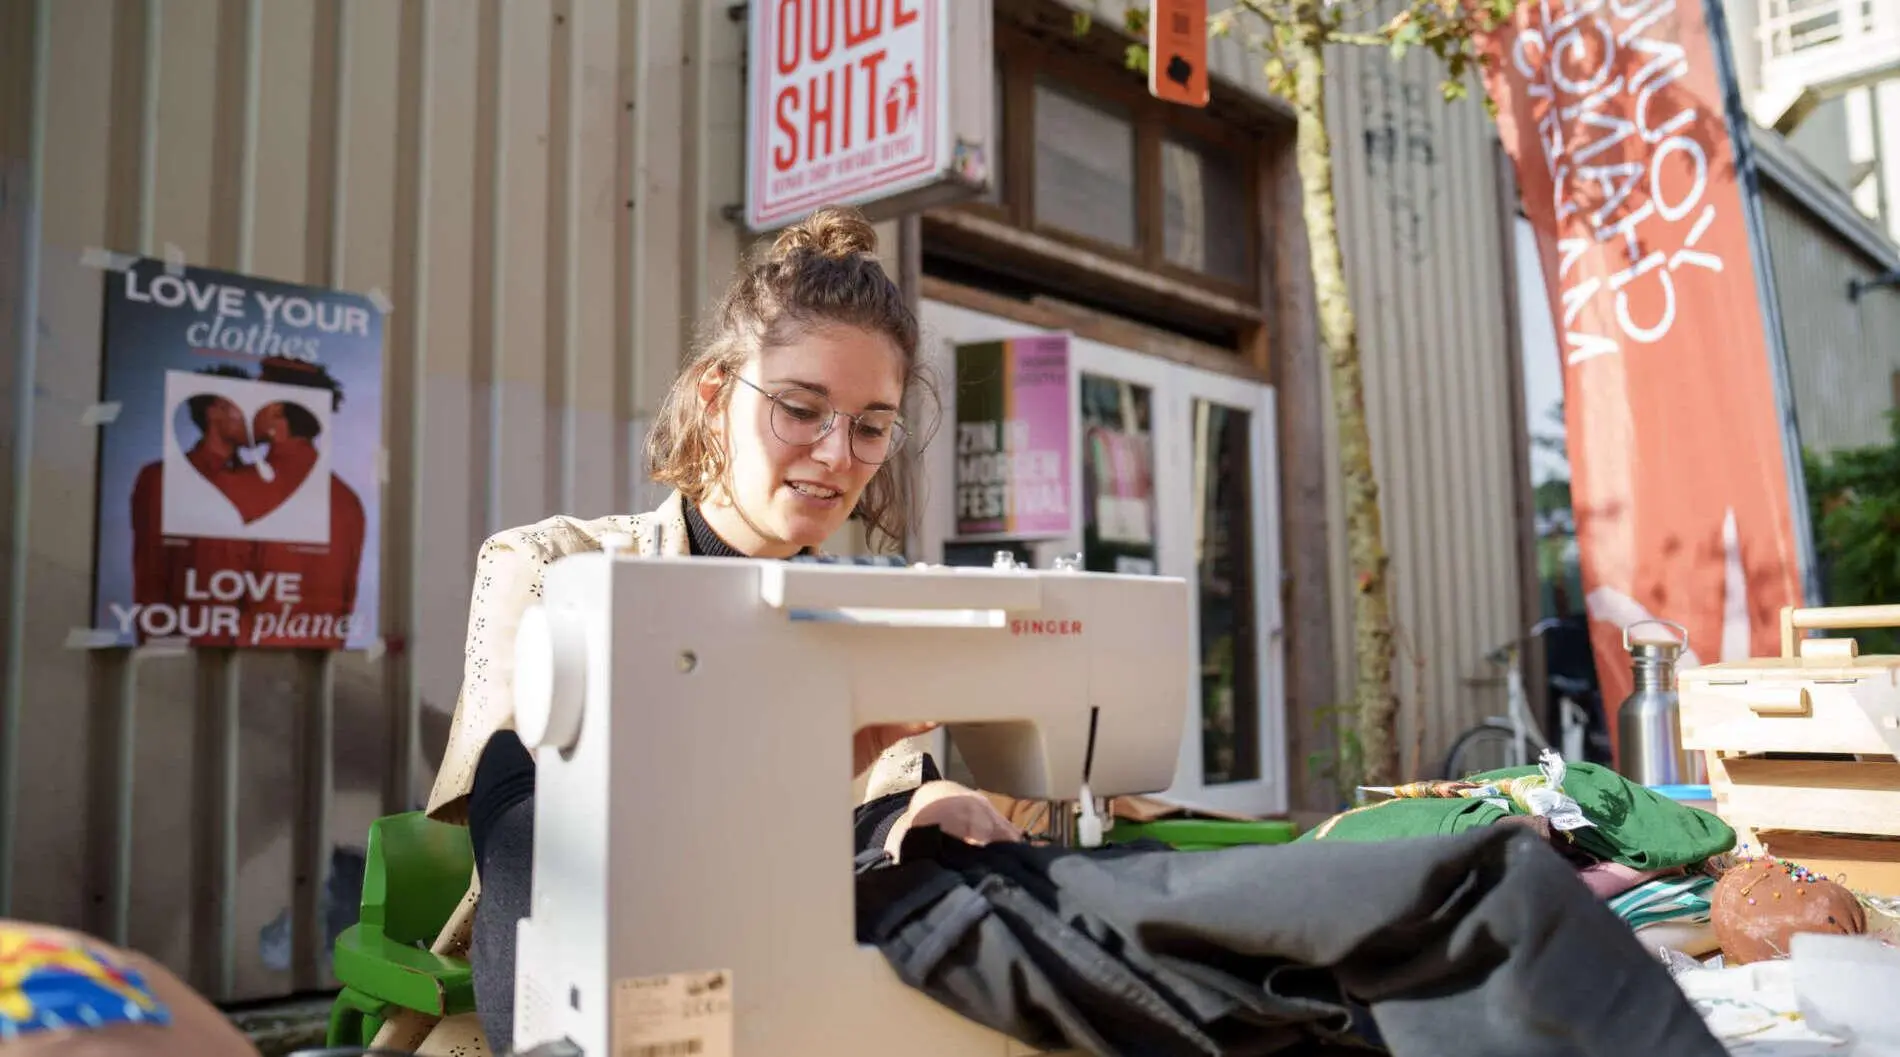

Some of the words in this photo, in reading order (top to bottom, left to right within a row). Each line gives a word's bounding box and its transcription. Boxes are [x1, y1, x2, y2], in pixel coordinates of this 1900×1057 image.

[774, 50, 887, 171] SHIT
[125, 269, 246, 318] LOVE
[254, 290, 370, 337] YOUR
[186, 315, 321, 361] clothes
[958, 450, 1062, 484] MORGEN
[958, 483, 1067, 518] FESTIVAL
[185, 568, 302, 603] LOVE
[109, 602, 241, 637] YOUR
[1010, 619, 1083, 636] SINGER
